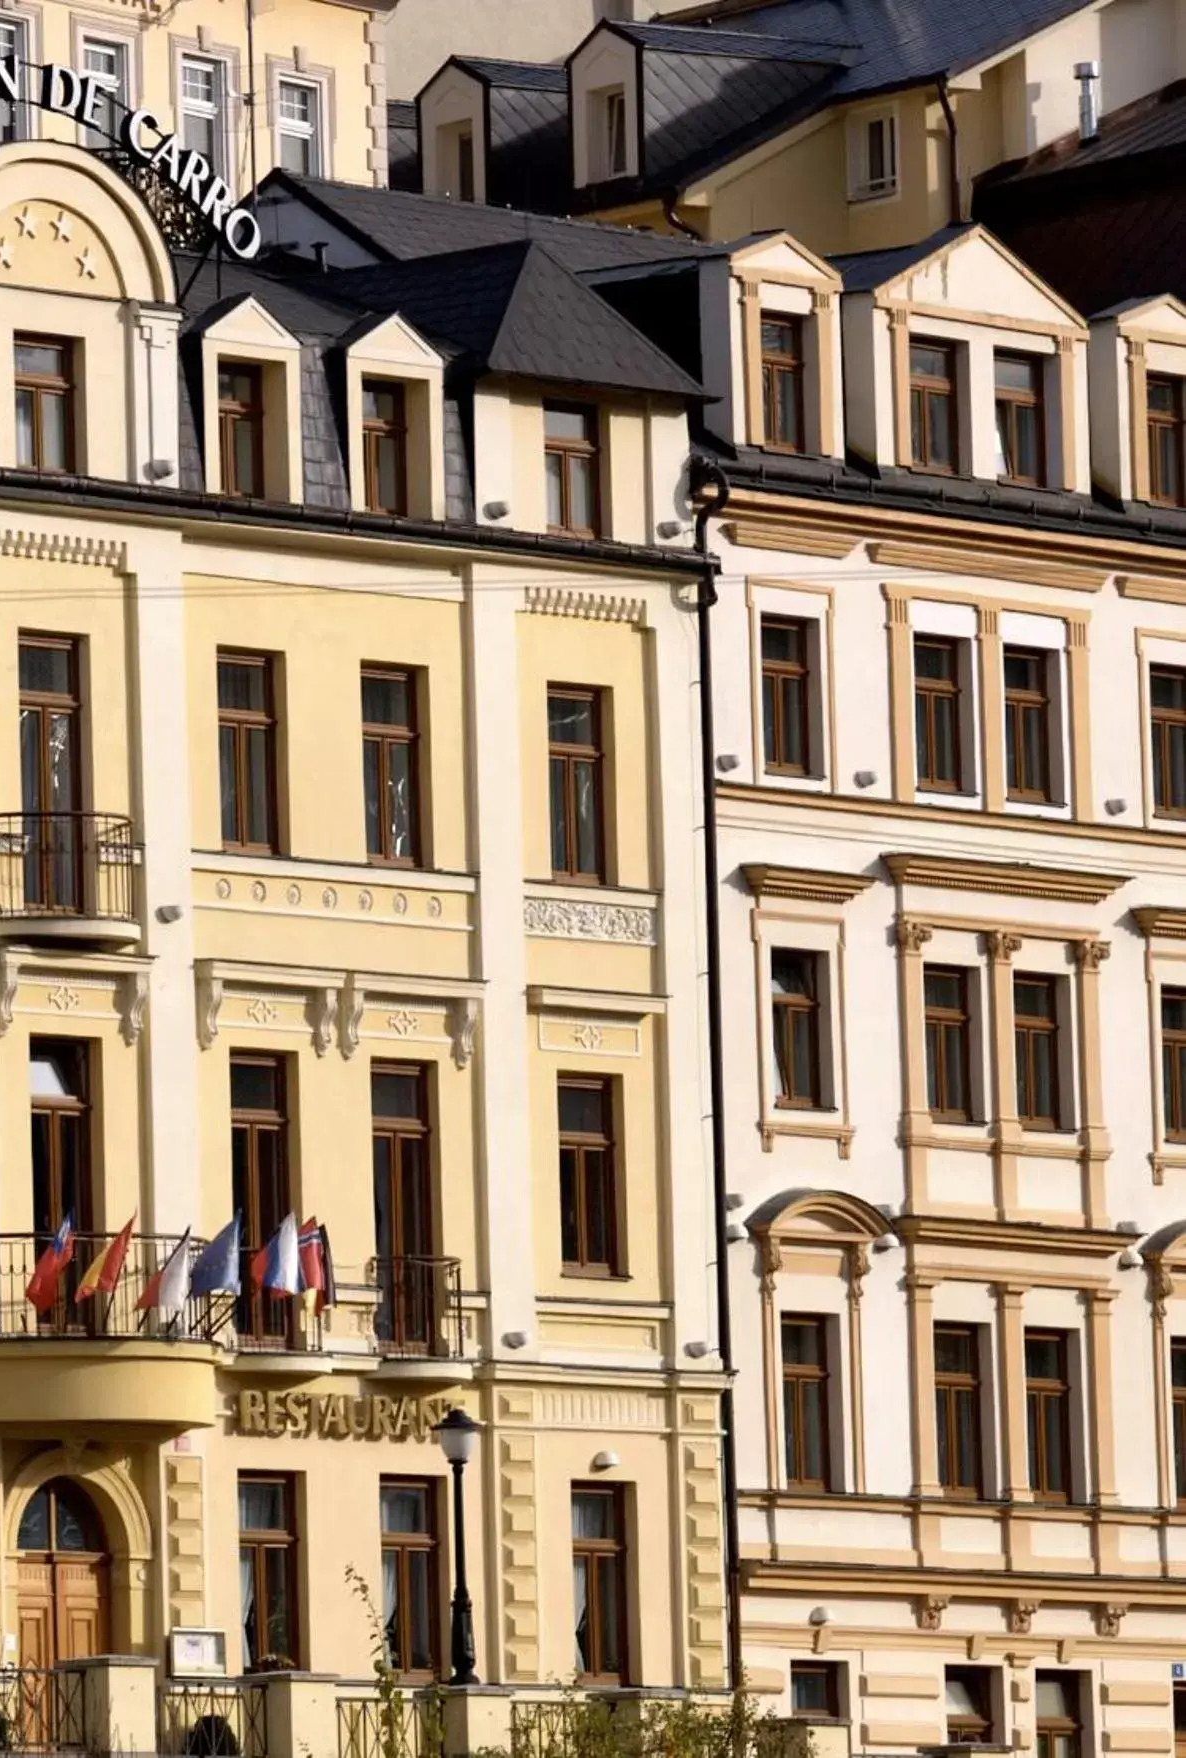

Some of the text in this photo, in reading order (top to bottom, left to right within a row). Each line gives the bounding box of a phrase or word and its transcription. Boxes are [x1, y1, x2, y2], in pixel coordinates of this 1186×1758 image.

[47, 63, 109, 127] DE
[125, 108, 262, 259] CARRO
[240, 1390, 465, 1438] RESTAURAN
